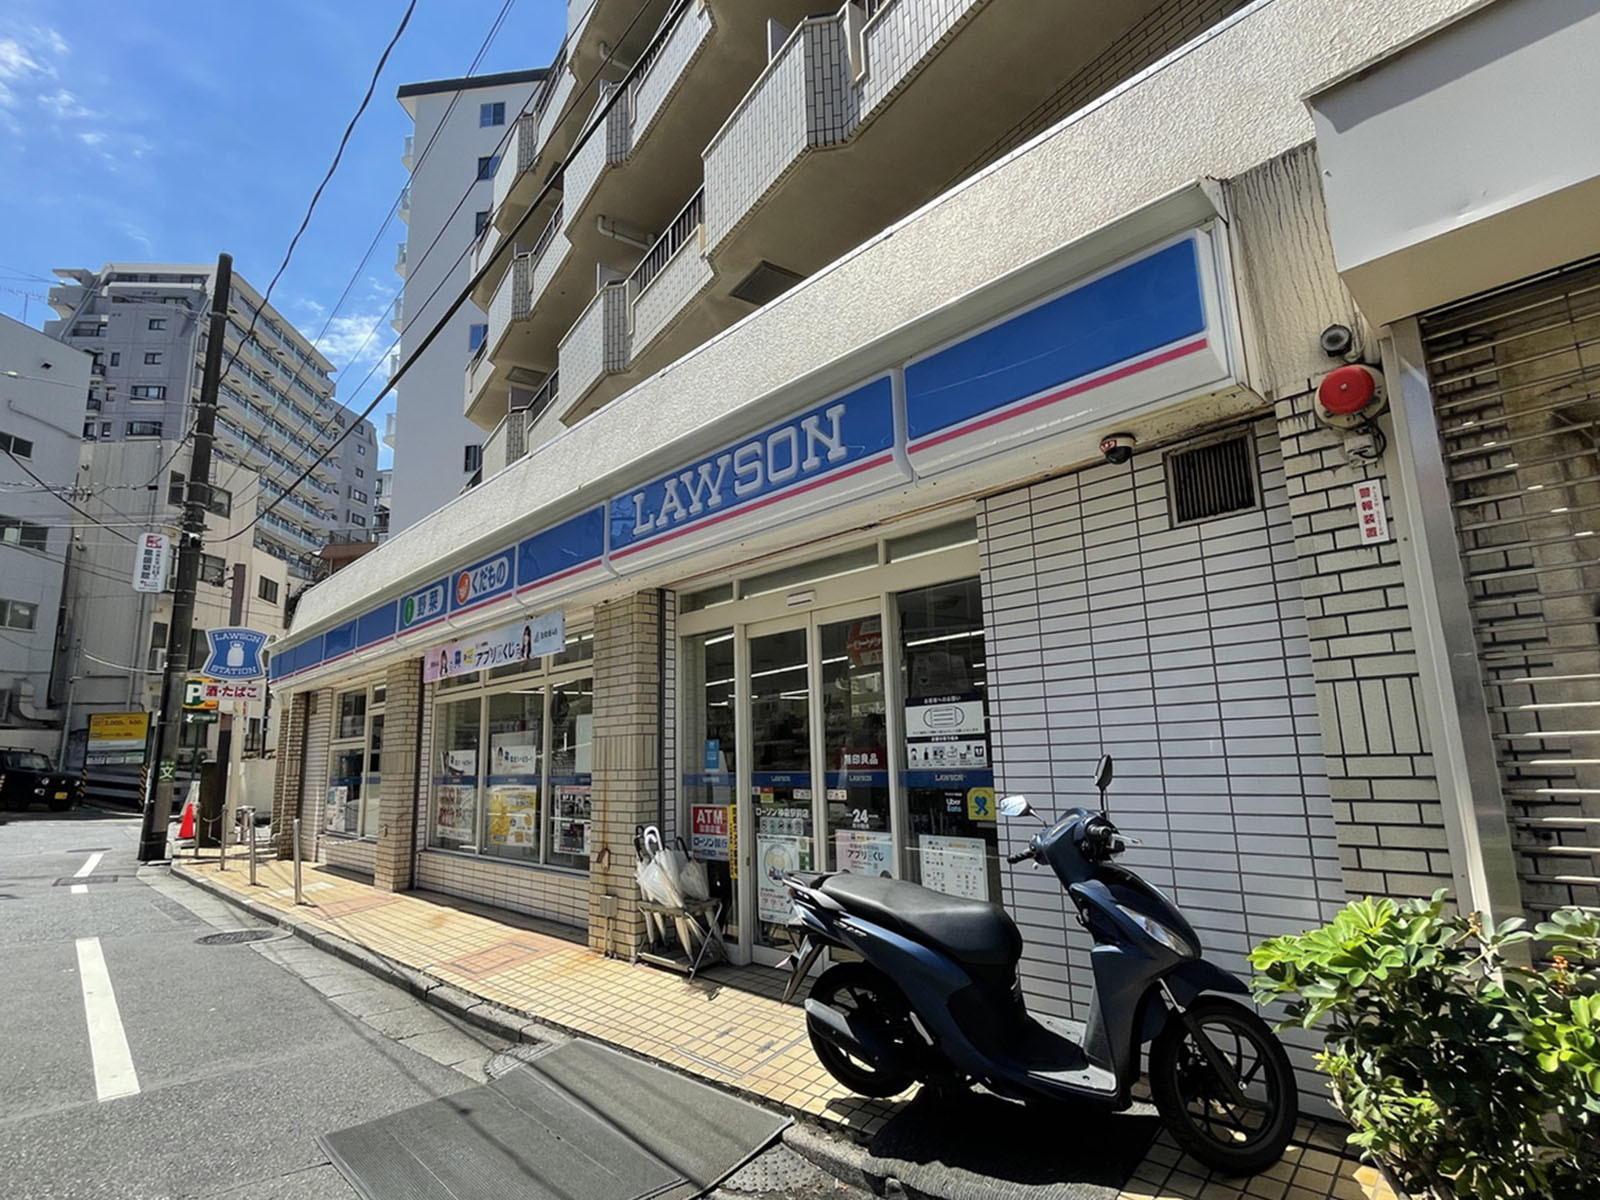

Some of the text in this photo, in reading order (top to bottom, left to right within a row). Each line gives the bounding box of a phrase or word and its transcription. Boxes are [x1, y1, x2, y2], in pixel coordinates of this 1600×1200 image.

[632, 404, 848, 536] LAWSON
[472, 561, 506, 594] くだもの
[416, 589, 439, 617] 野菜
[214, 632, 262, 643] LAWSON
[210, 664, 257, 675] STATION
[185, 684, 202, 703] P
[206, 685, 257, 698] 酒・たばこ
[697, 809, 723, 824] ATM
[852, 809, 869, 823] 24
